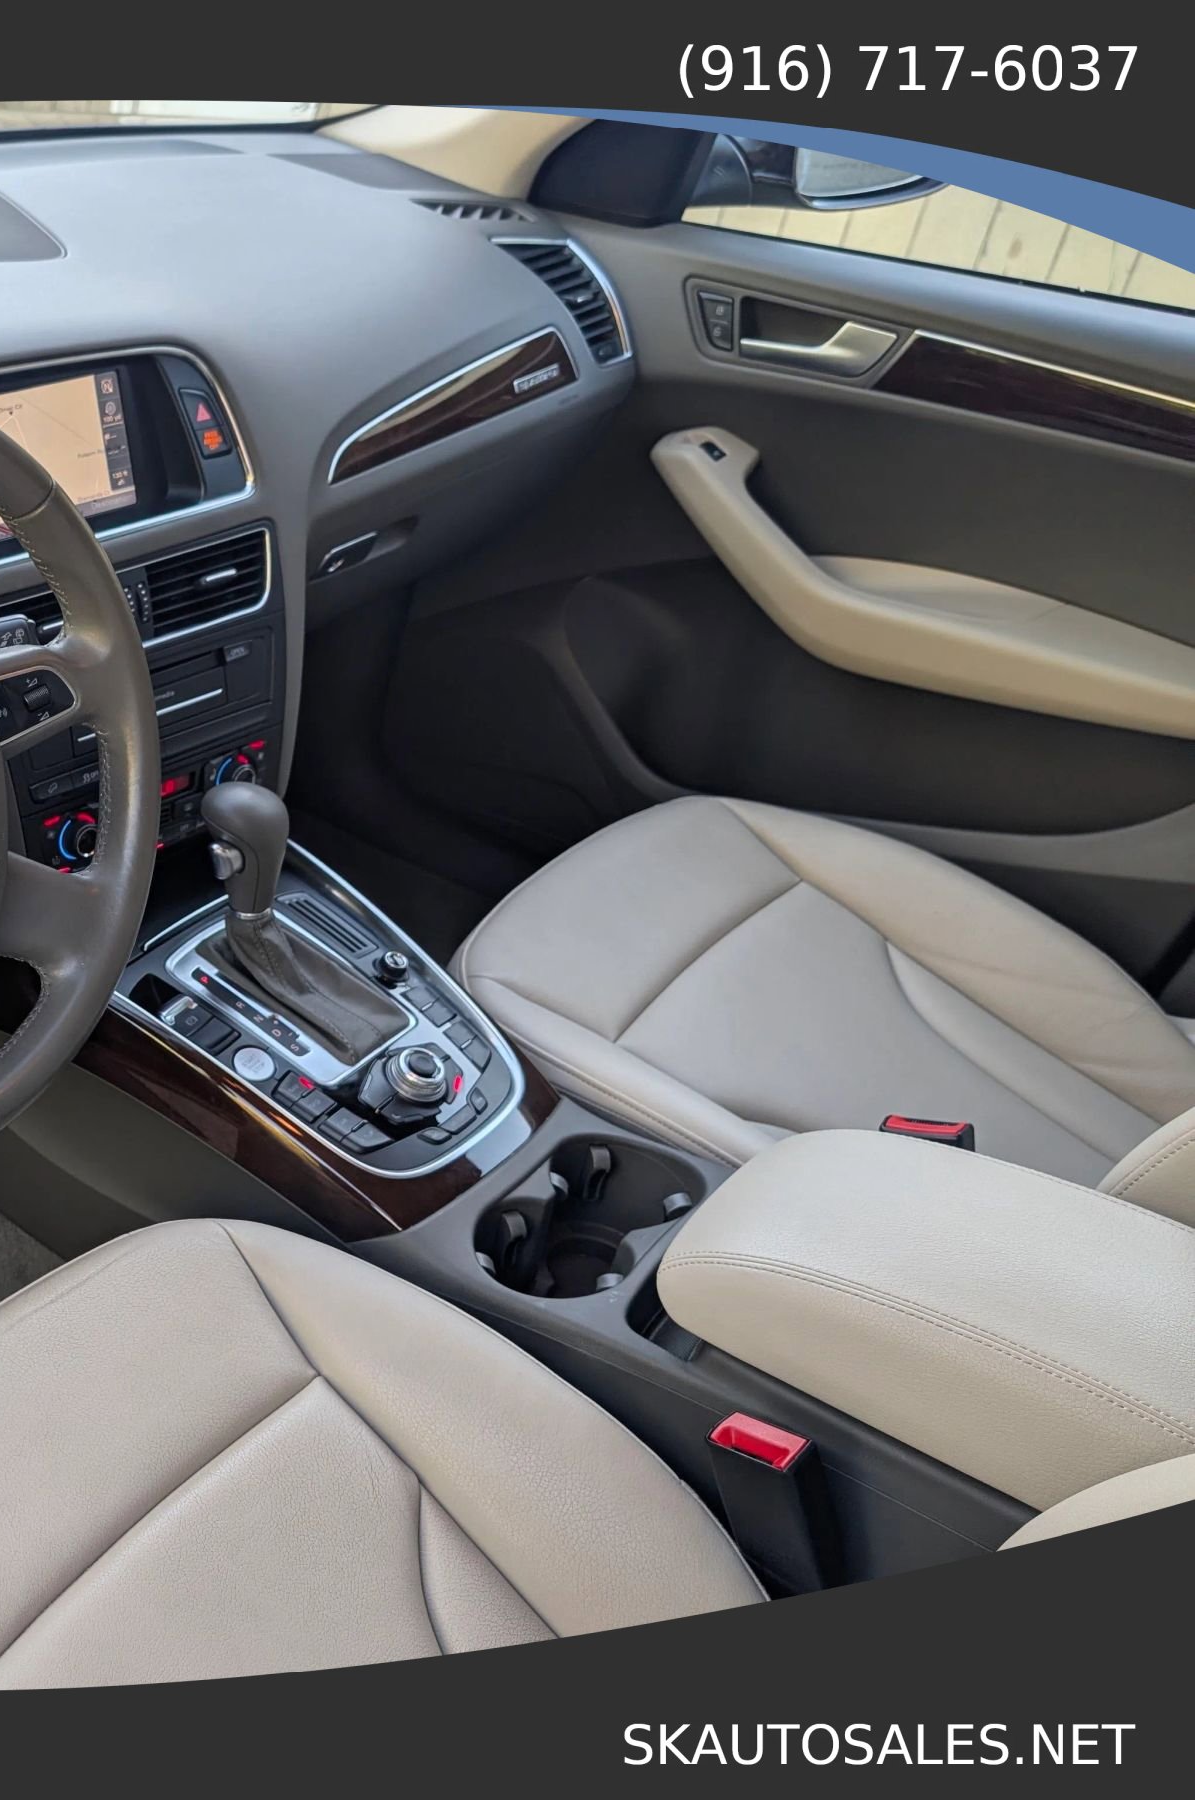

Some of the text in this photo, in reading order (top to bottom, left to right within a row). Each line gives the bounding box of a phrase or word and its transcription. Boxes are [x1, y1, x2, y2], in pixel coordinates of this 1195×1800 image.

[200, 975, 210, 984] P
[272, 1028, 282, 1038] D
[290, 1043, 300, 1052] S
